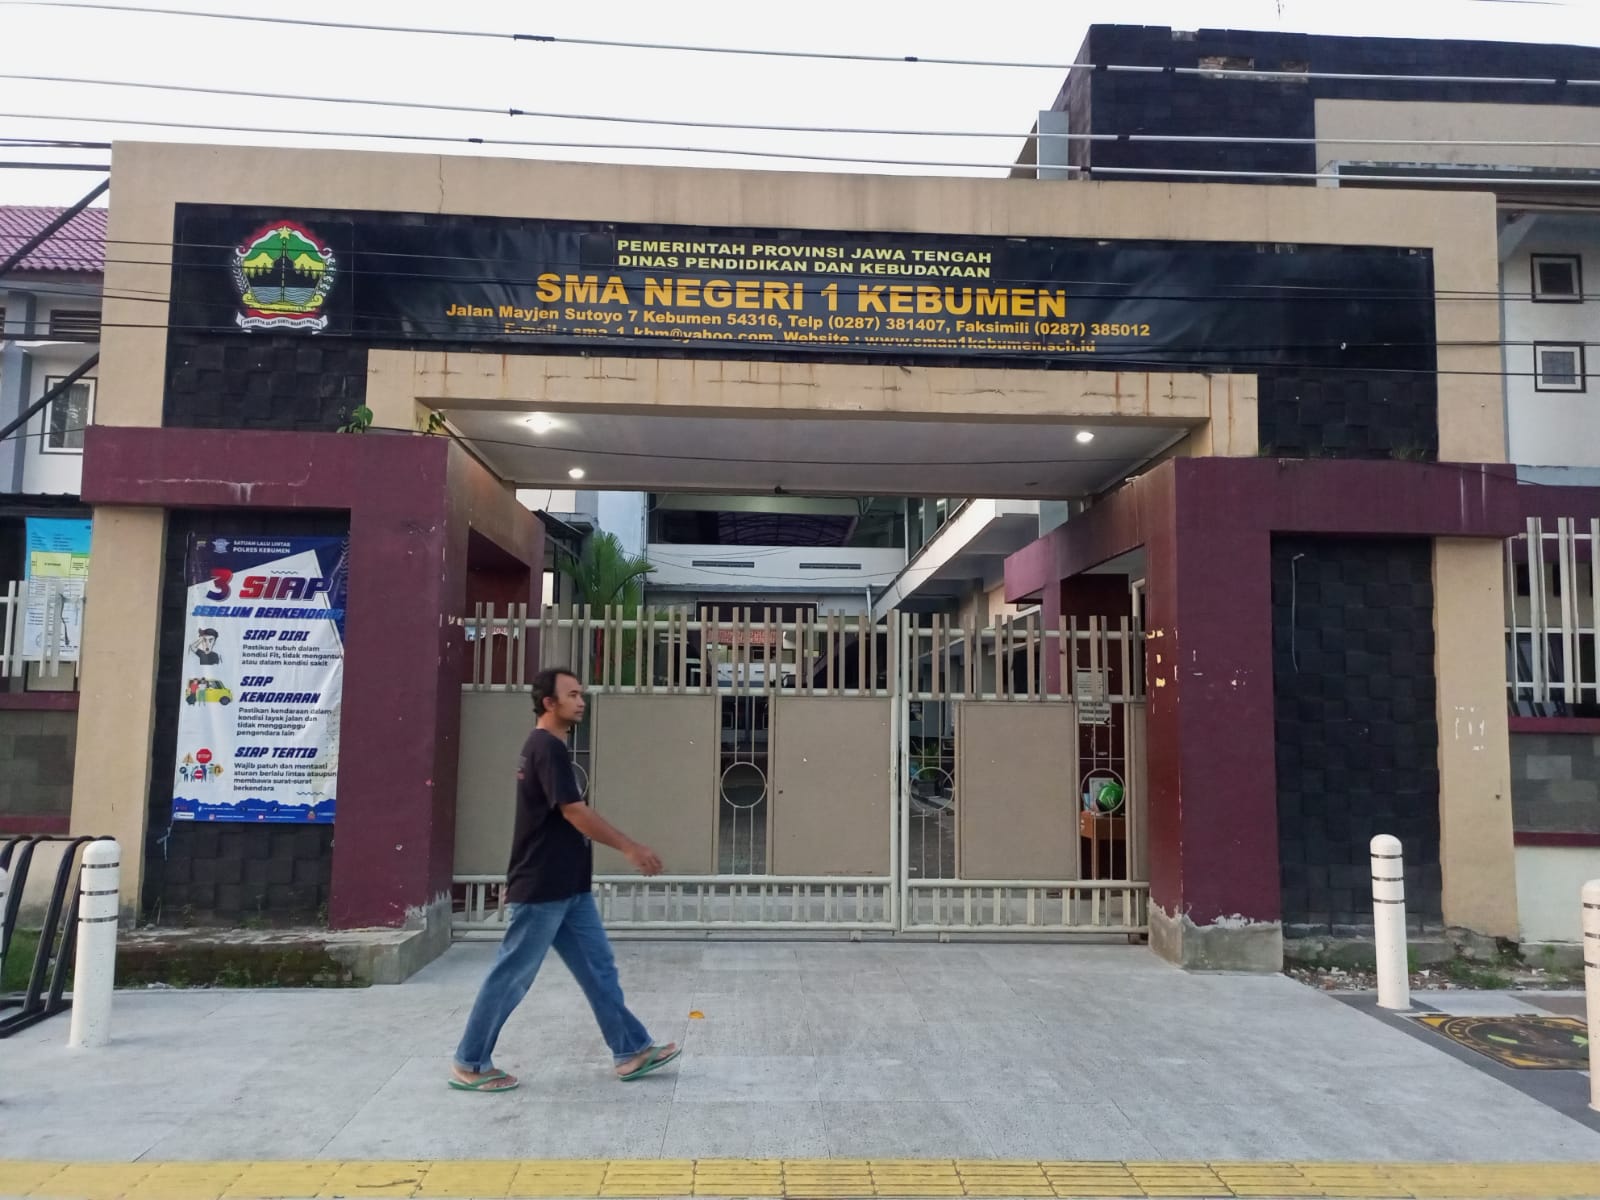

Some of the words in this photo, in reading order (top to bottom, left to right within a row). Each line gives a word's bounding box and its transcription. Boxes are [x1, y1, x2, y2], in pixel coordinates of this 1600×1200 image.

[617, 239, 746, 257] PEMERINTAH
[752, 244, 844, 259] PROVINSI
[851, 248, 906, 261] JAWA
[911, 250, 992, 264] TENGAH
[617, 254, 679, 269] DINAS
[685, 257, 808, 274] PENDIDIKAN
[814, 261, 855, 274] DAN
[860, 263, 991, 278] KEBUDAYAAN
[535, 273, 630, 306] SMA
[644, 277, 804, 311] NEGERI
[820, 283, 838, 311] 1
[857, 284, 1067, 318] KEBUMEN
[446, 303, 494, 318] Jalan
[498, 305, 560, 323] Mayjen
[565, 308, 623, 324] Sutoyo
[628, 310, 637, 322] 7
[643, 310, 722, 325] Kebumen
[727, 313, 783, 328] 54316,
[788, 315, 823, 331] Telp
[828, 315, 880, 331] (0287)
[885, 317, 951, 334] 381407,
[955, 320, 1030, 335] Faksimili
[1034, 321, 1086, 337] (0287)
[1091, 322, 1151, 337] 385012
[206, 568, 234, 601] 3
[238, 575, 334, 602] SIAP
[191, 605, 254, 618] SEBELUM
[242, 629, 277, 641] SIAP
[242, 644, 274, 652] Pastikan
[242, 651, 268, 659] kondisi
[283, 659, 309, 667] kondisi
[239, 675, 274, 687] SIAP
[270, 707, 309, 715] kendaraan
[234, 746, 270, 758] SIAP
[234, 762, 256, 770] Wajib
